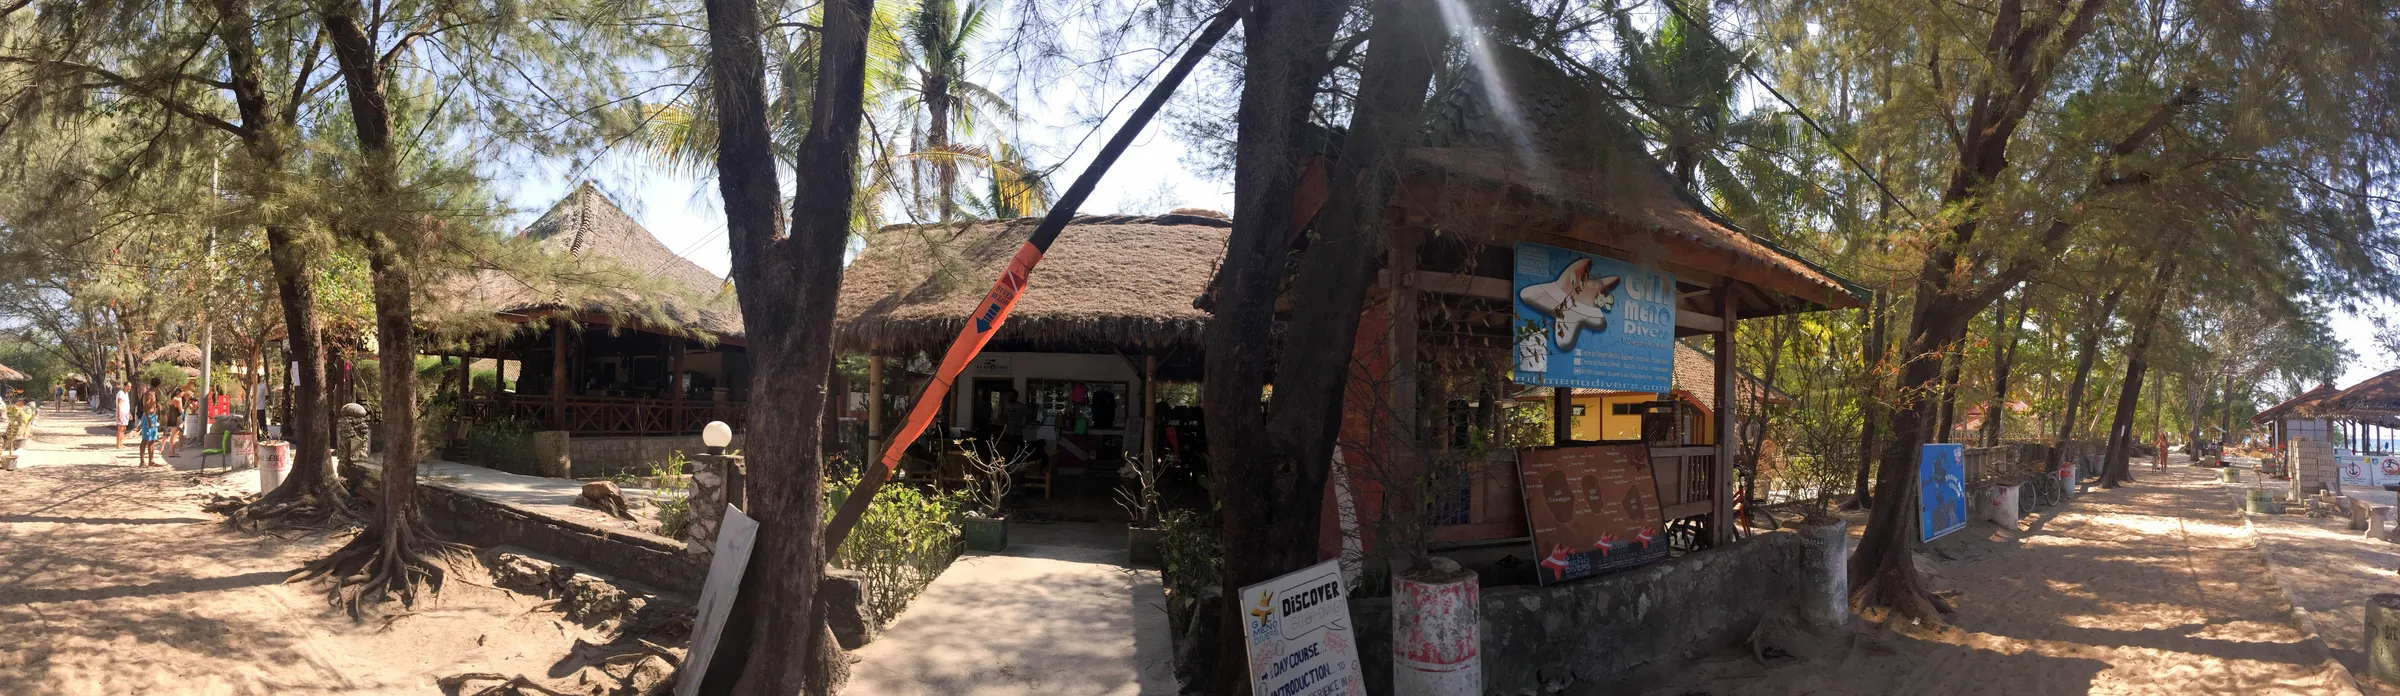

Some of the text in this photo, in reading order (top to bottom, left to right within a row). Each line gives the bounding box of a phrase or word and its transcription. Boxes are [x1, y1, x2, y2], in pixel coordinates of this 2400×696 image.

[1515, 374, 1671, 392] gilmenodivers.com
[1253, 620, 1278, 637] MENO
[1273, 656, 1288, 677] DAY
